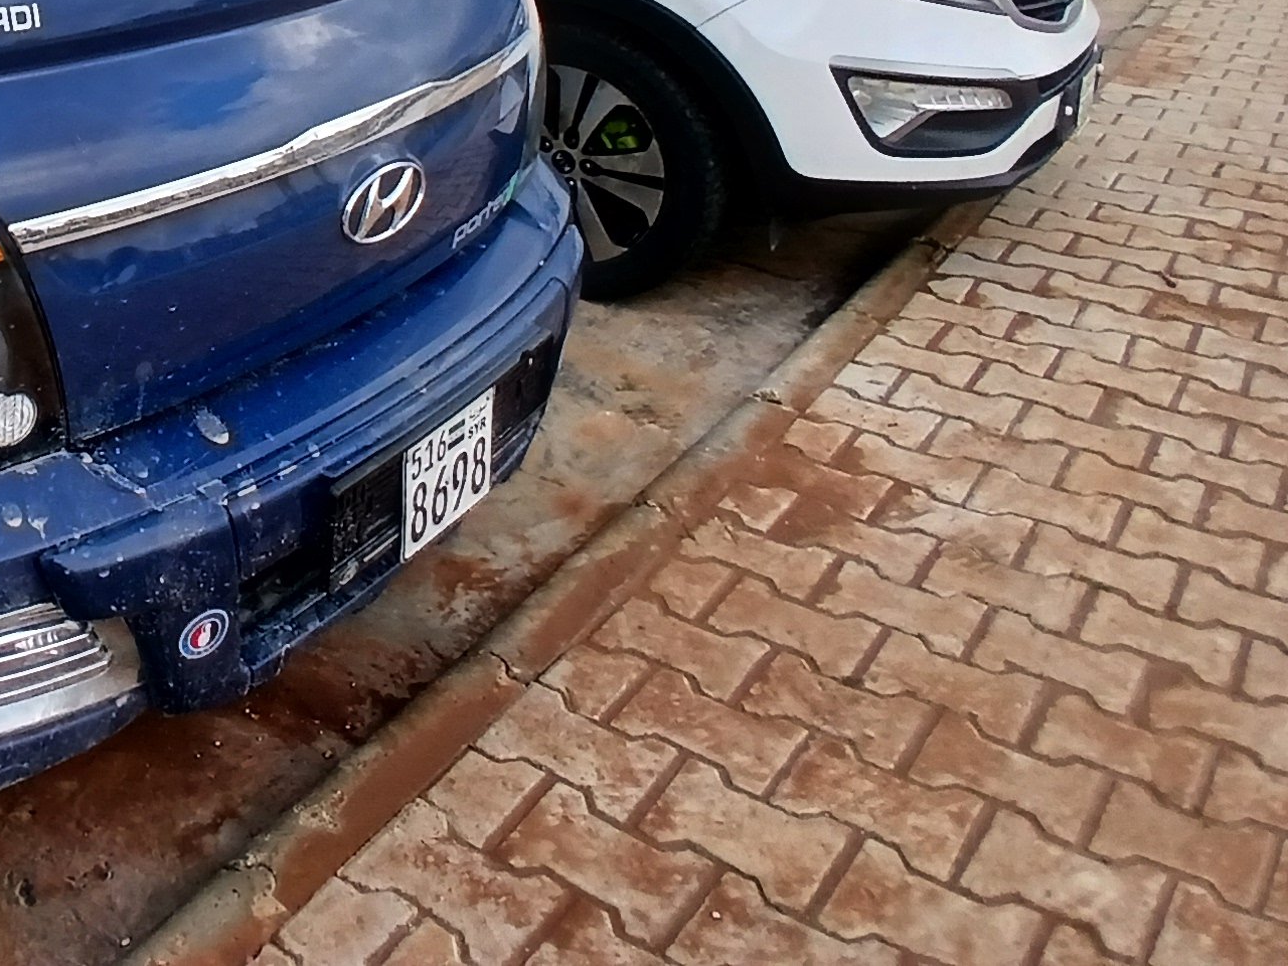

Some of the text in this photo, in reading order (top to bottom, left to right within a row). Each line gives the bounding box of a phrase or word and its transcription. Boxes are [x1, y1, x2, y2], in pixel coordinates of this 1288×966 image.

[467, 416, 487, 439] SYR
[411, 430, 447, 481] 516
[411, 436, 487, 543] 8698
